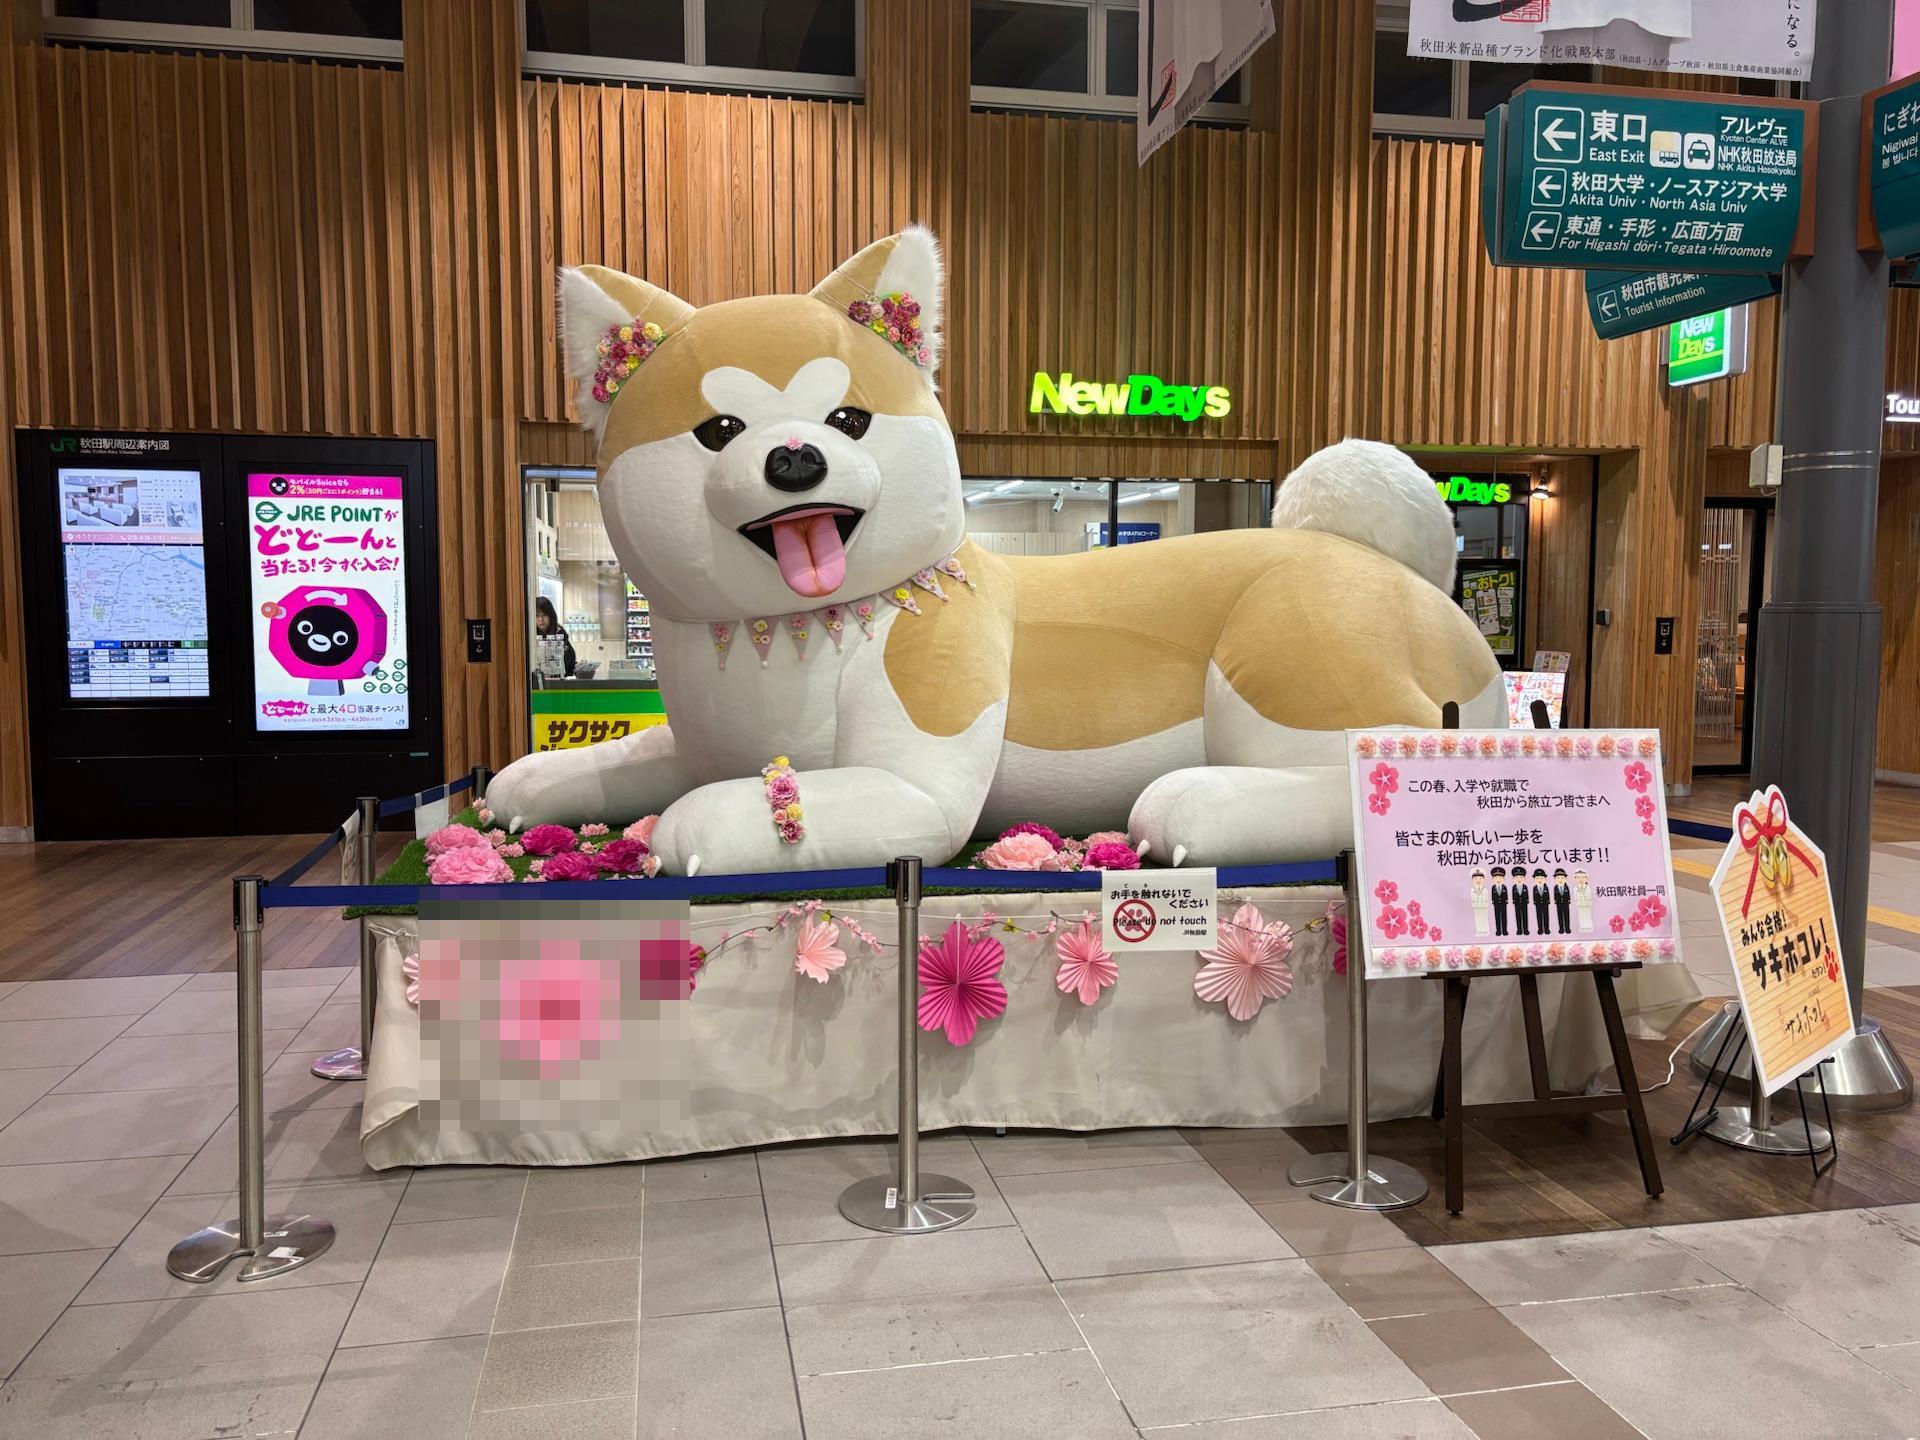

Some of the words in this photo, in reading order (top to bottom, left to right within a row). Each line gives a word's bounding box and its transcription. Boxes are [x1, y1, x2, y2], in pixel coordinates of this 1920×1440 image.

[1420, 38, 1616, 61] 秋田米新品種ブランド化戦略本部
[1589, 109, 1647, 143] 東口
[1721, 115, 1788, 138] アルヴェ
[1745, 135, 1768, 145] Center
[1769, 138, 1788, 146] ALVE
[1882, 132, 1918, 155] Nigiwai
[1589, 147, 1617, 162] East
[1620, 149, 1645, 163] Exit
[1717, 145, 1797, 168] NHK秋田放送局
[1717, 163, 1733, 171] NHK
[1736, 164, 1755, 173] Akita
[1571, 171, 1788, 202] 秋田大学・ノースアジア大学
[1569, 193, 1604, 206] Akita
[1609, 195, 1637, 208] Univ
[1650, 197, 1685, 211] North
[1689, 199, 1716, 212] Asia
[1721, 201, 1748, 213] Univ
[1559, 237, 1580, 249] For
[1584, 237, 1630, 253] Higashi
[1624, 301, 1654, 317] Tourist
[1655, 286, 1706, 308] Information
[1679, 315, 1714, 339] New
[1678, 336, 1715, 359] Days
[1030, 372, 1231, 421] NewDays
[50, 438, 76, 452] JR
[80, 437, 169, 451] 秋田駅周辺案内図
[287, 505, 325, 521] JRE
[548, 720, 630, 743] サクサク
[1408, 778, 1530, 793] この春、入学や就職で
[1477, 795, 1611, 809] 秋田から旅立つ皆さまへ
[1395, 828, 1543, 847] 皆さまの新しい一歩を
[1110, 889, 1191, 900] お手を触れないで
[1596, 885, 1665, 897] 秋田駅社員一同
[1169, 899, 1209, 909] ください
[1114, 917, 1142, 927] Please
[1145, 917, 1157, 926] do
[1160, 917, 1177, 926] not
[1180, 916, 1207, 925] touch
